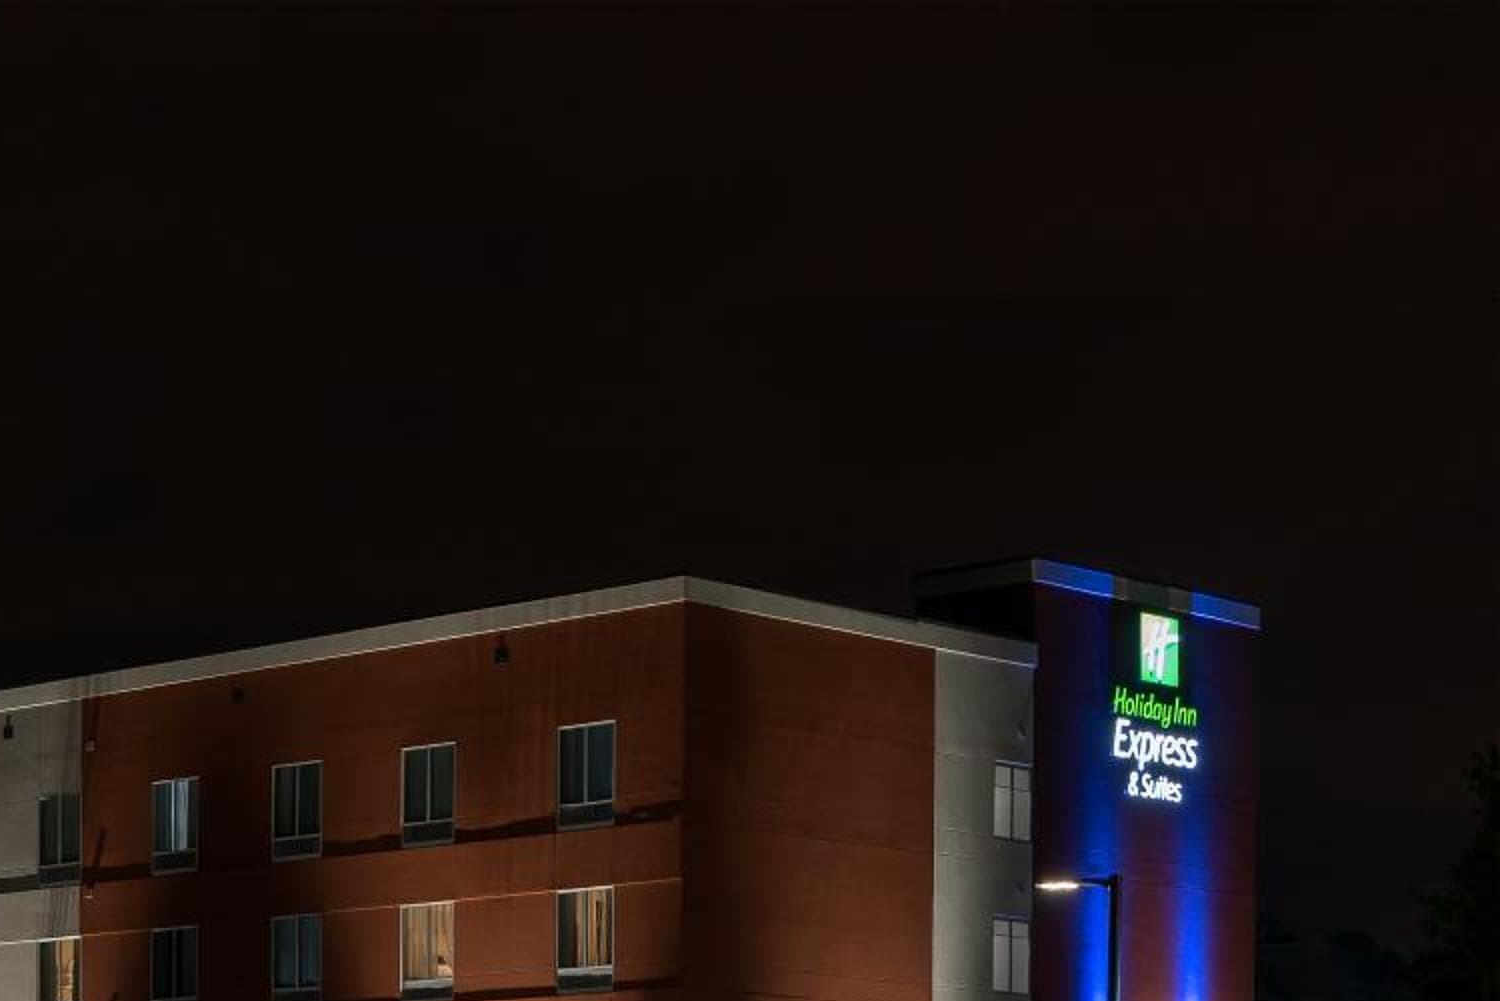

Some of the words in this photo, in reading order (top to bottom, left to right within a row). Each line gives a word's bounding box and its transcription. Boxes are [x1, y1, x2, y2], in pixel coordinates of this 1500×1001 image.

[1113, 686, 1173, 729] Holiday
[1173, 697, 1197, 727] Inn
[1113, 717, 1198, 771] Express
[1127, 771, 1139, 797] &
[1140, 773, 1182, 802] Suites
